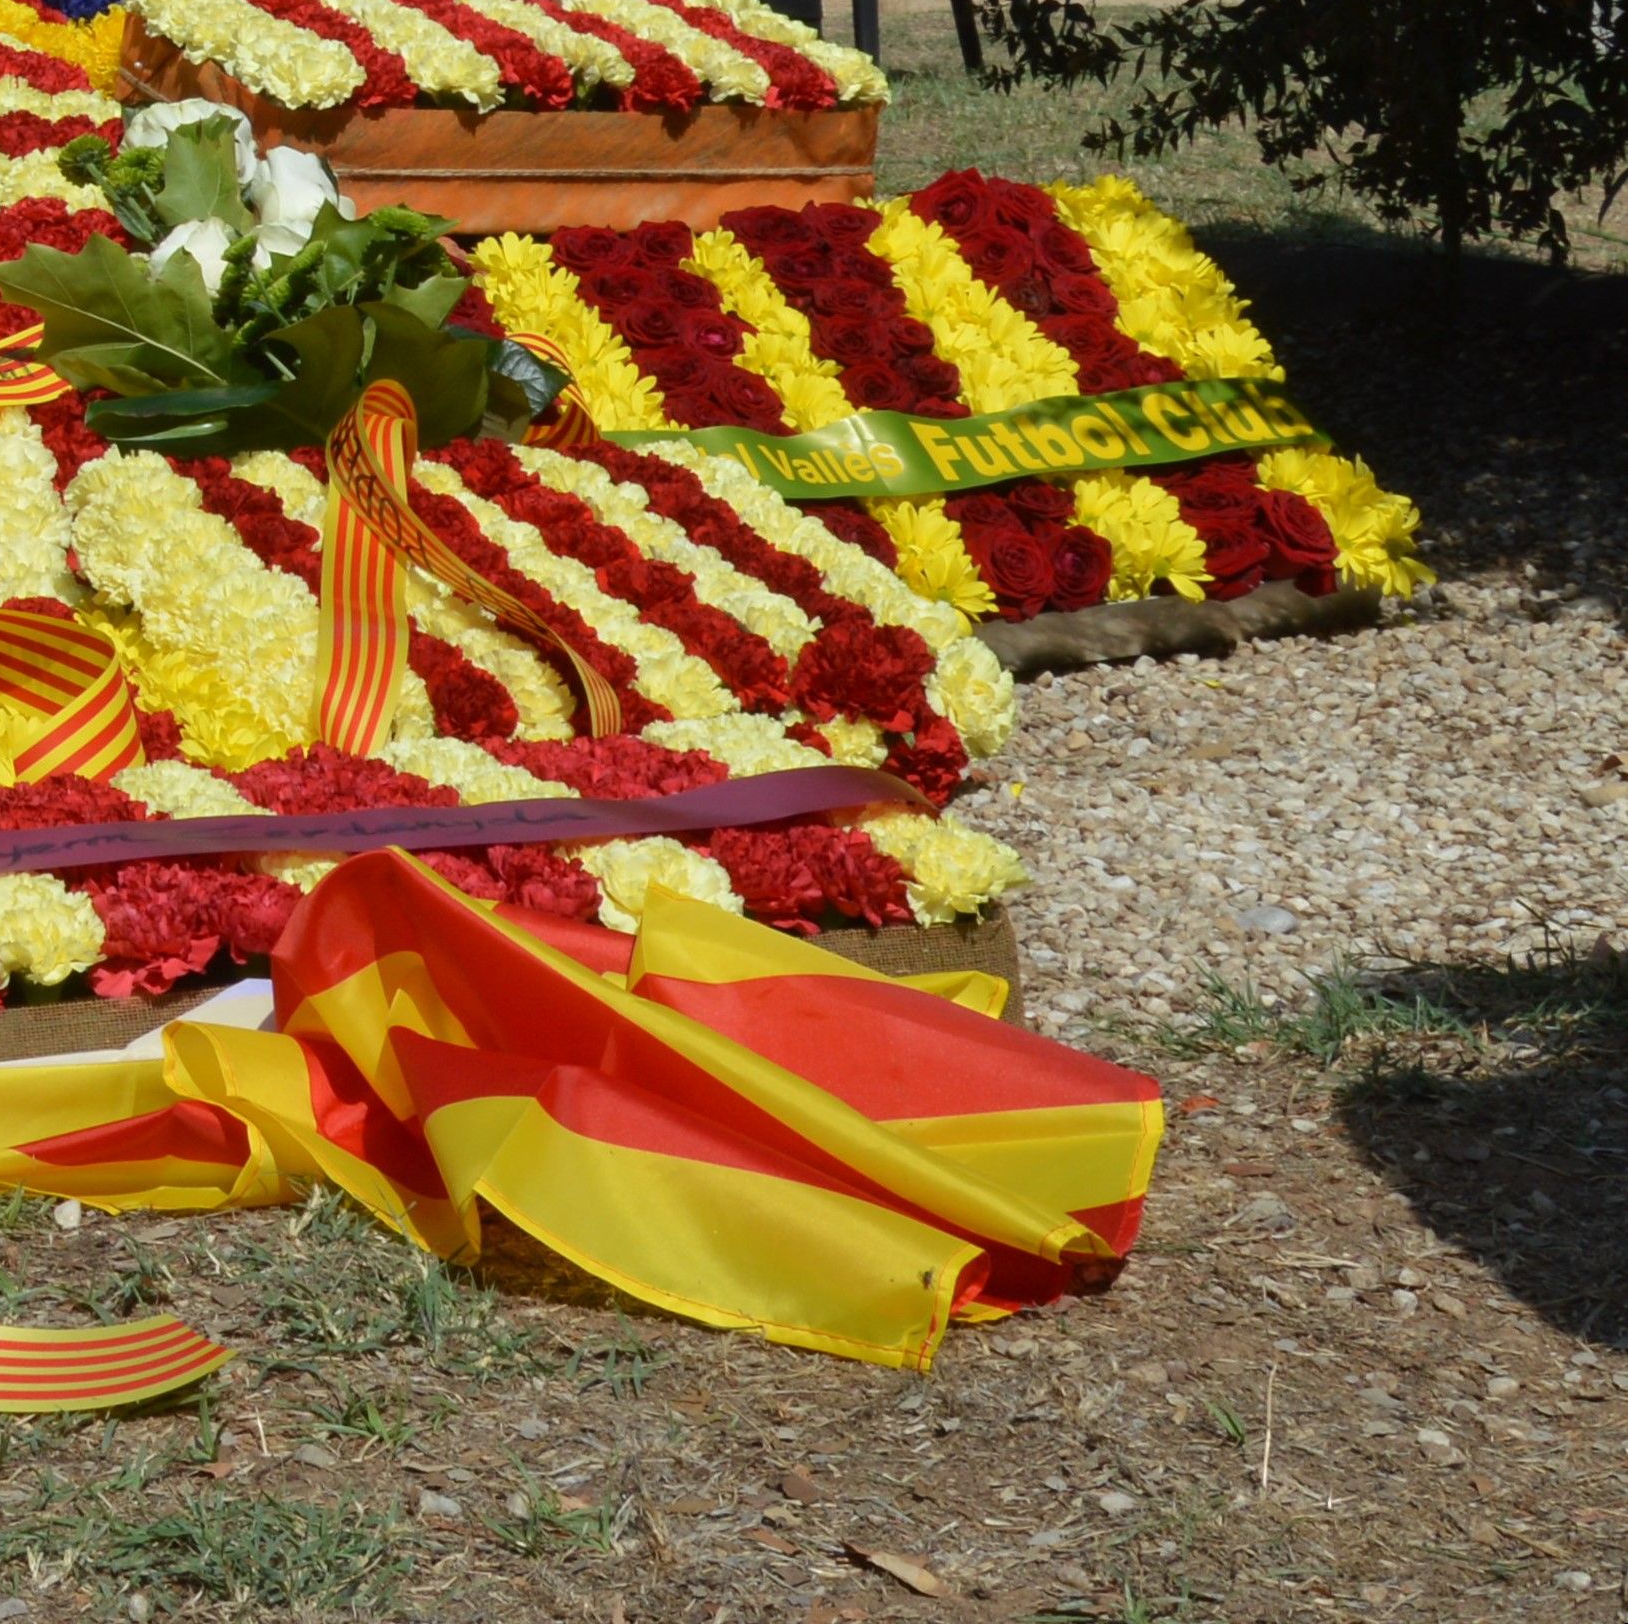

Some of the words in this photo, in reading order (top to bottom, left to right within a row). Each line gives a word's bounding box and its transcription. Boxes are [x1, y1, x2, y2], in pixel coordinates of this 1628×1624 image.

[757, 442, 905, 485] Vallès
[909, 401, 1152, 482] Futbol
[1142, 382, 1315, 452] Club
